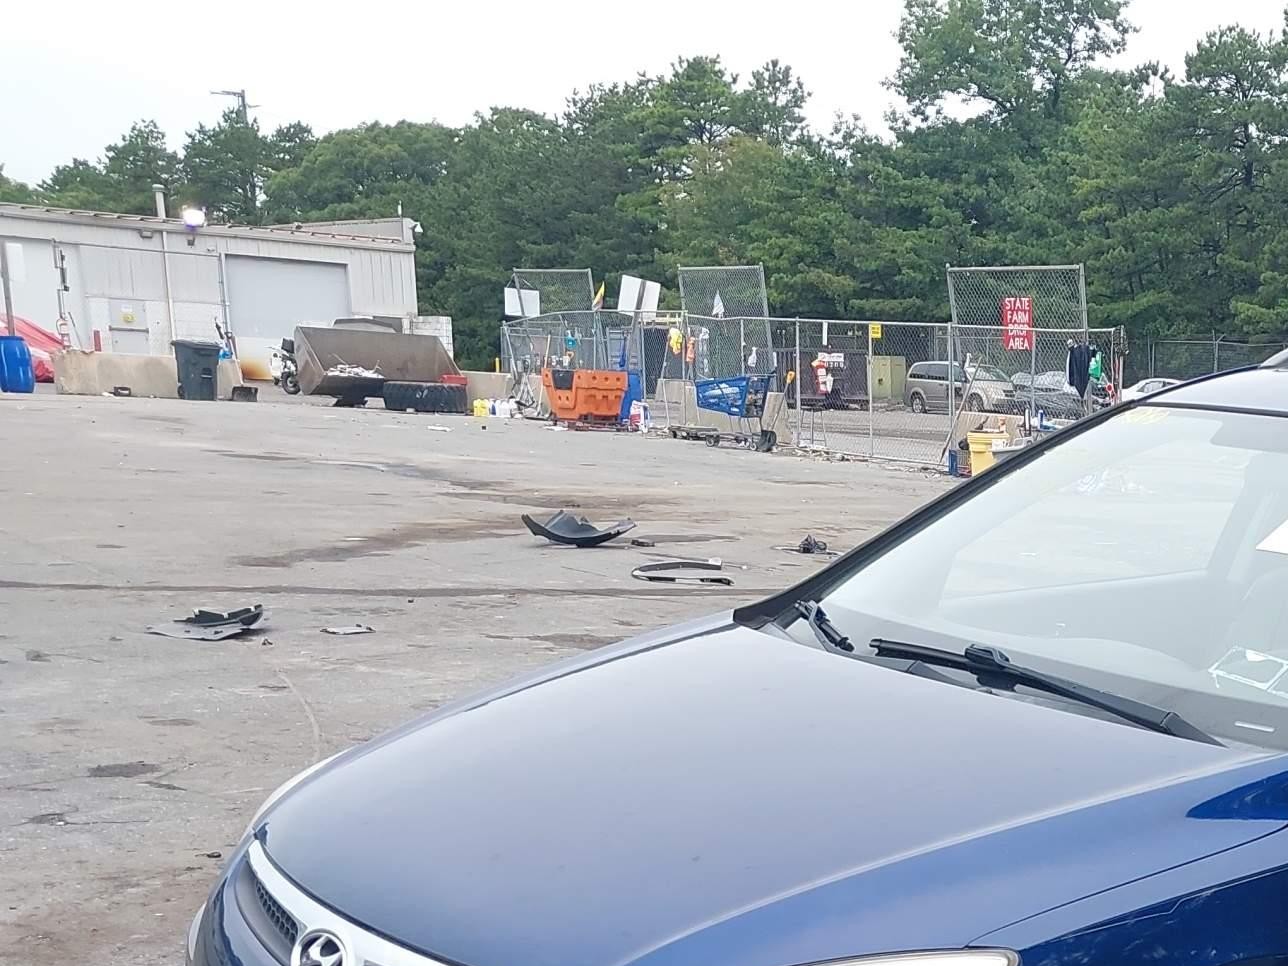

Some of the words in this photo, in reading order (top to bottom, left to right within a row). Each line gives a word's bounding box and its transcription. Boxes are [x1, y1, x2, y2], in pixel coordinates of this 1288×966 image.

[1005, 297, 1030, 310] STATE
[1007, 310, 1029, 323] FARM
[1008, 337, 1030, 350] AREA
